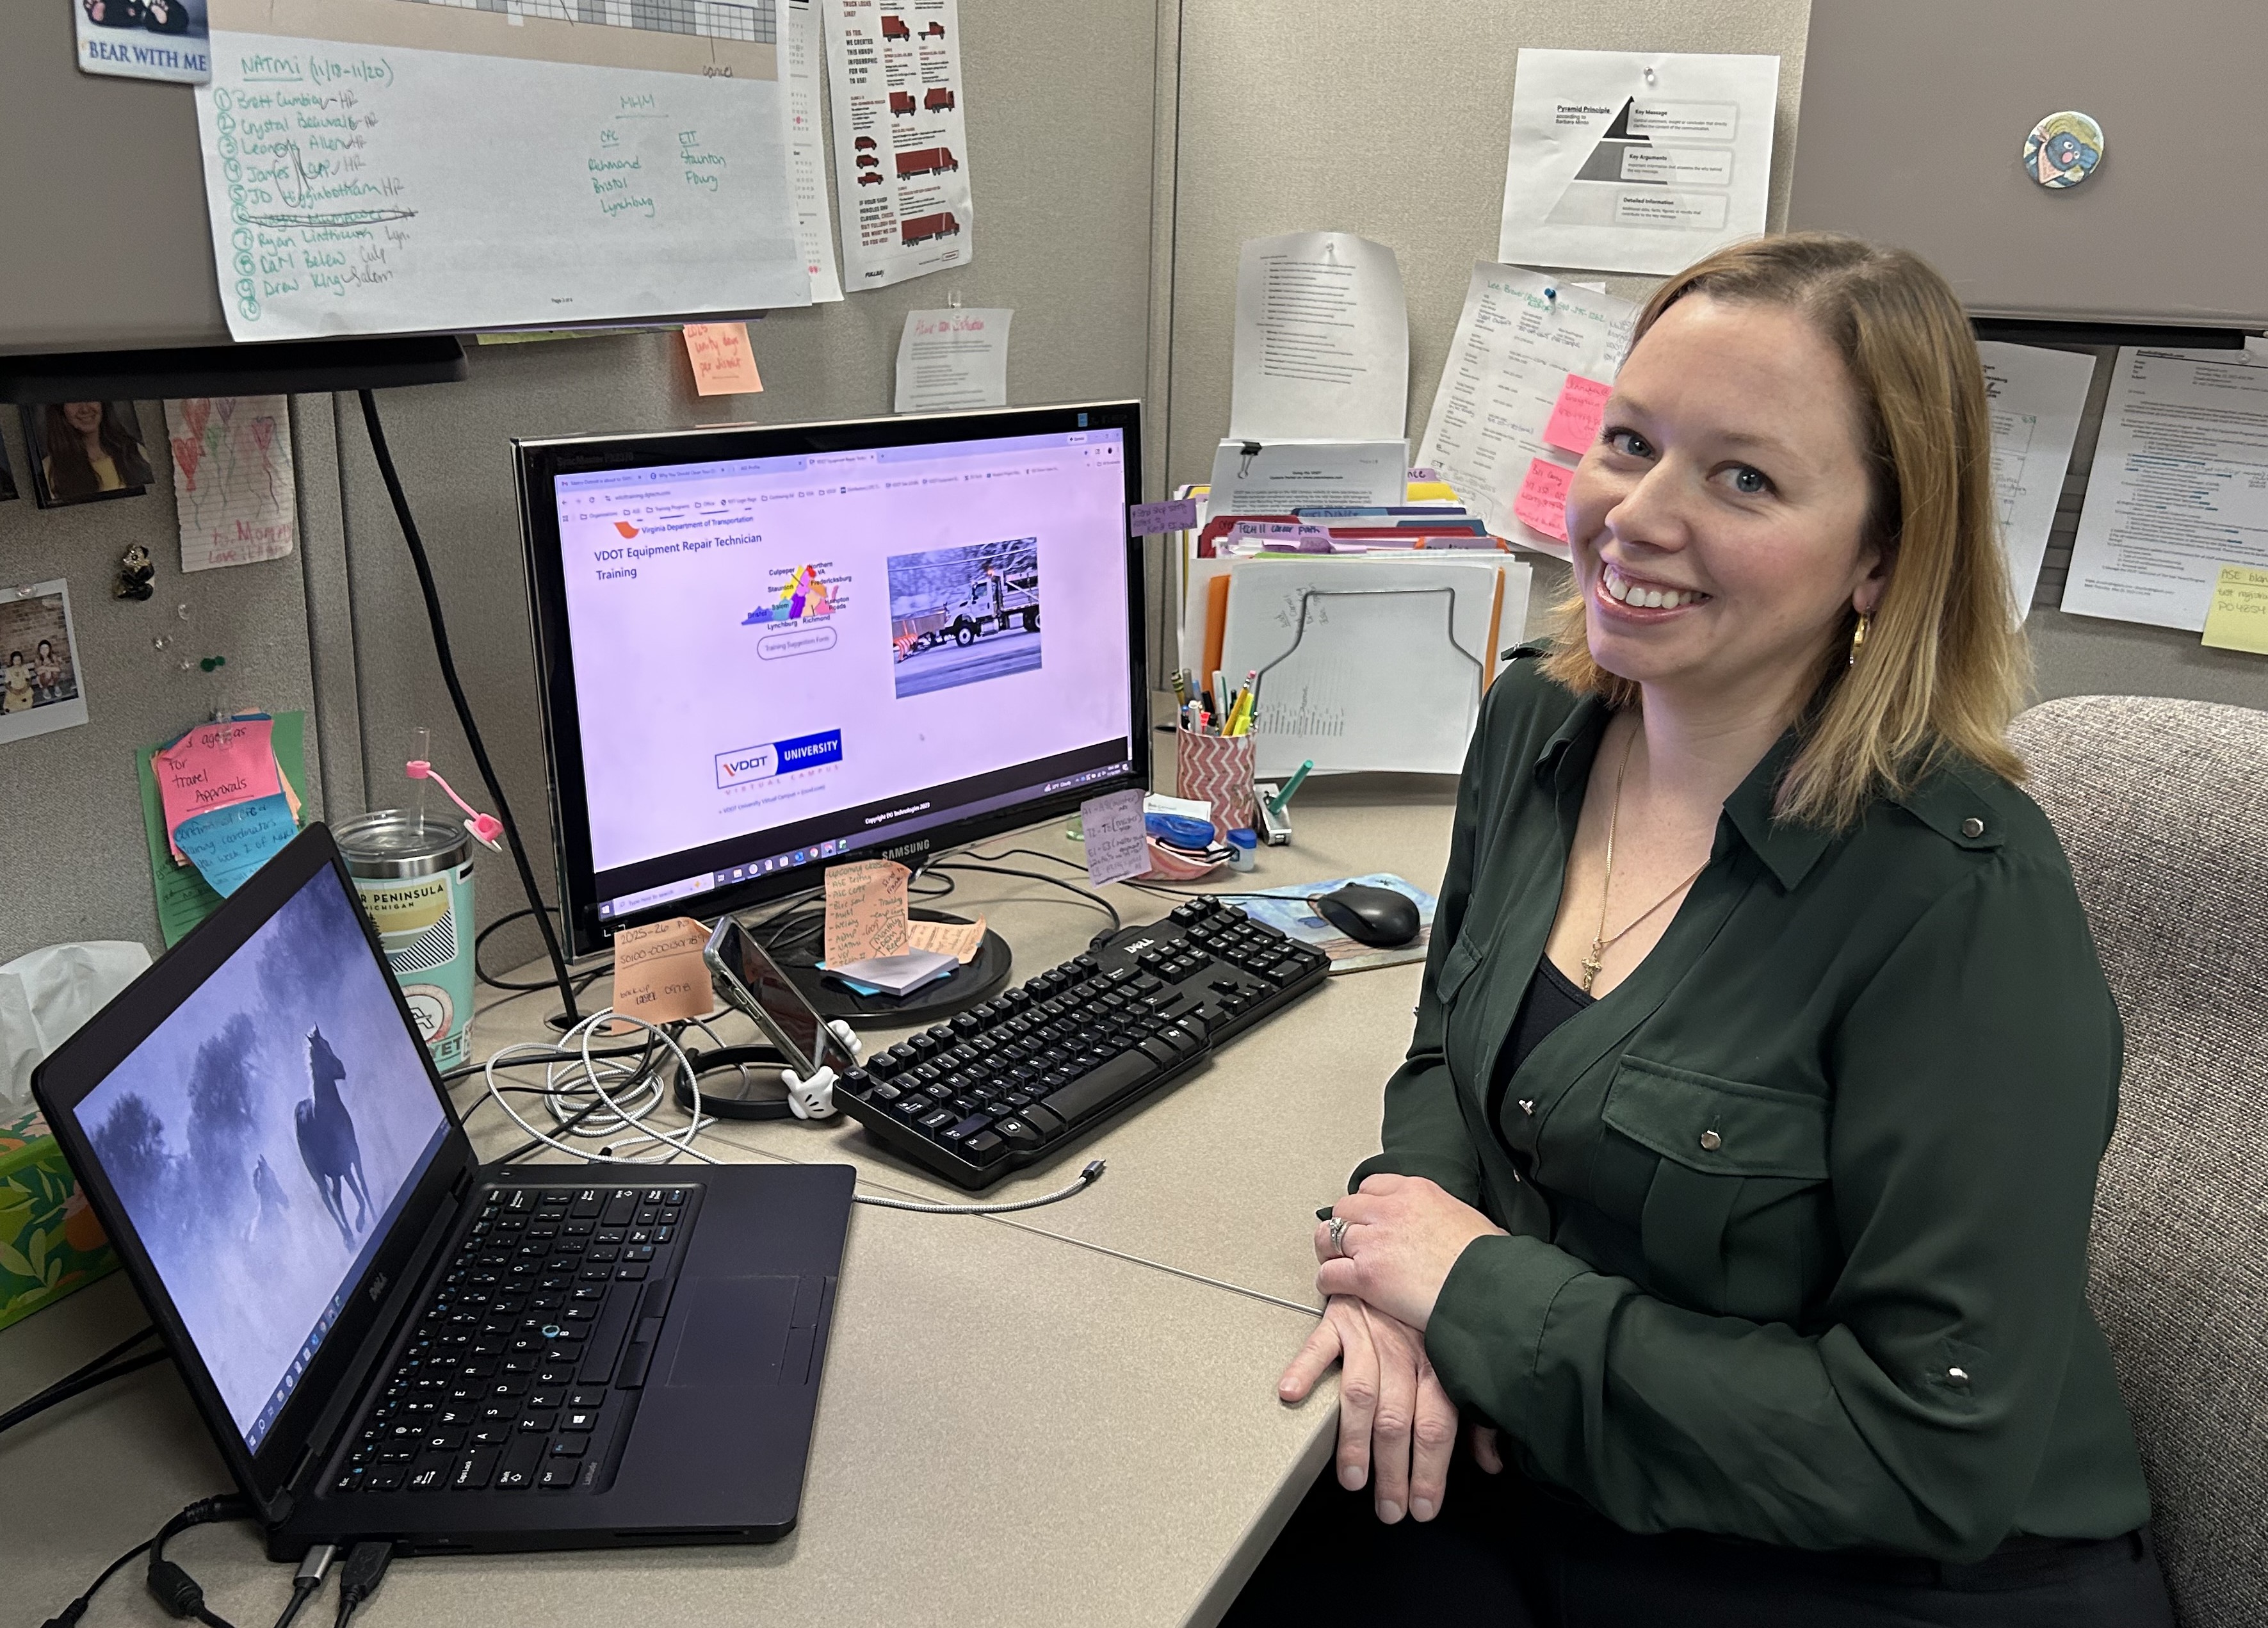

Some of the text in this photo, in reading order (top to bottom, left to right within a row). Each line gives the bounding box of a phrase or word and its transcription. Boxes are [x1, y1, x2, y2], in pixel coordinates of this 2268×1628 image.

[89, 41, 207, 71] BEAR WITH ME
[591, 177, 628, 193] Bristol
[642, 525, 666, 534] Virginia
[667, 520, 703, 532] Department
[712, 516, 754, 527] Transportation
[1298, 525, 1320, 535] path
[594, 533, 762, 561] VDOT Equipment Repair Technician
[596, 567, 637, 581] Training
[769, 567, 795, 576] Culpeper
[768, 584, 794, 592] Staunton
[811, 576, 852, 586] Fredericksburg
[825, 596, 850, 605] Hampton
[767, 621, 798, 630] Lynchburg
[803, 615, 830, 624] Richmond
[765, 643, 786, 651] Training
[730, 740, 838, 772] VDOT UNIVERSITY
[172, 769, 208, 788] travel
[725, 765, 838, 795] VIRTUAL CAMPUS
[195, 777, 247, 803] Approvals
[865, 814, 886, 824] Copyright
[894, 806, 919, 817] Technologies
[882, 839, 930, 860] SAMSUNG
[374, 884, 444, 904] PENINSULA
[1124, 938, 1154, 954] DELL
